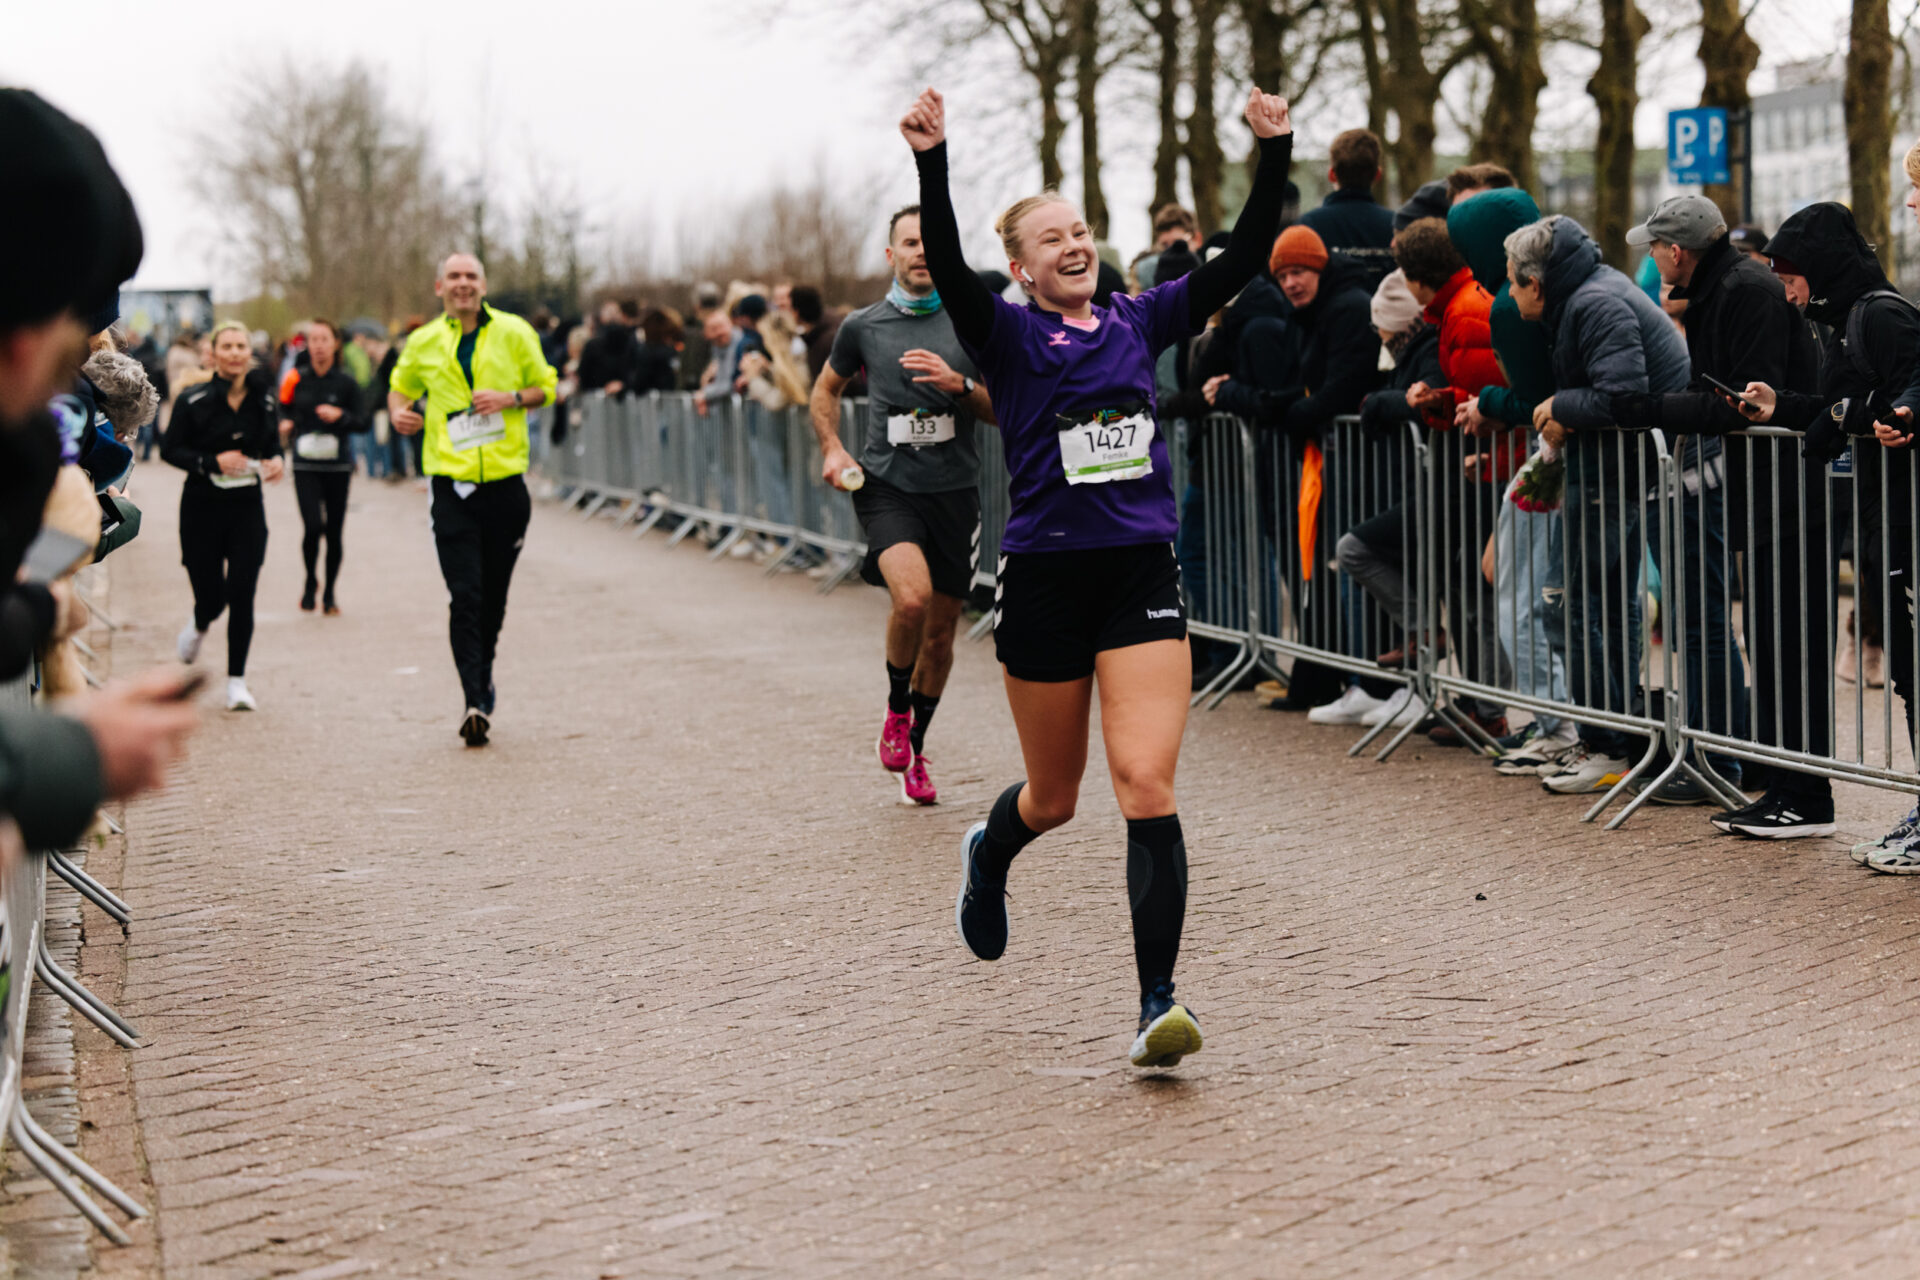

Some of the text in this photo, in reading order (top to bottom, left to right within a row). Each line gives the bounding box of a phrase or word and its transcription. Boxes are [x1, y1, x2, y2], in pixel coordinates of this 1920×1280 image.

[1675, 117, 1699, 160] P
[909, 420, 936, 434] 133
[1085, 424, 1136, 453] 1427
